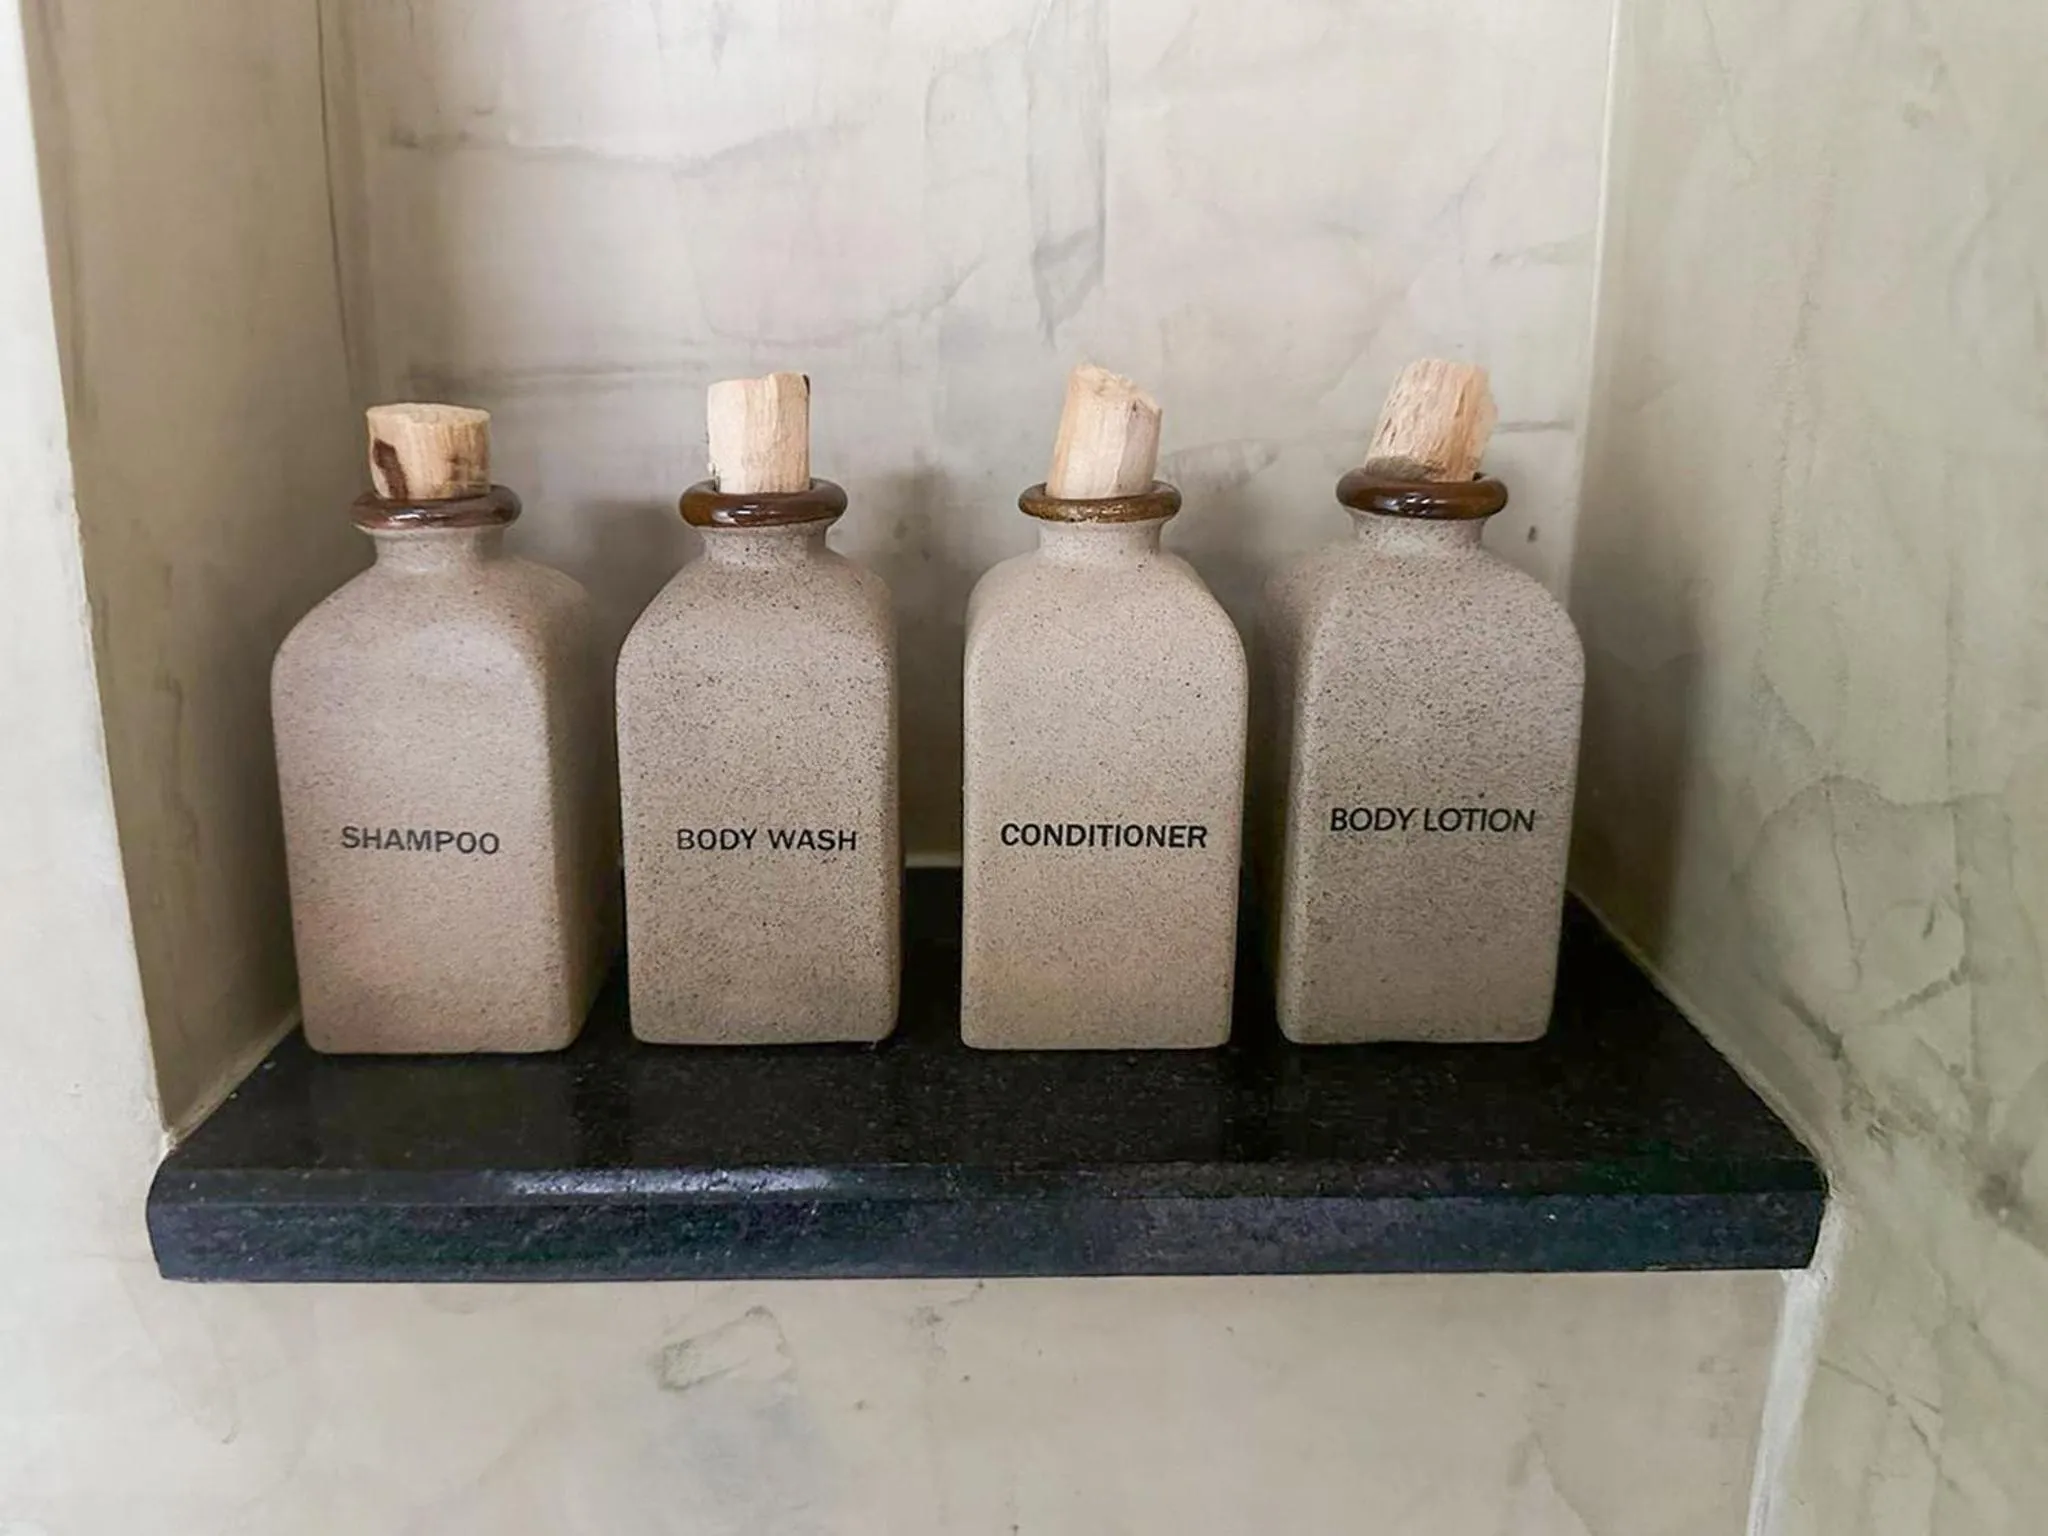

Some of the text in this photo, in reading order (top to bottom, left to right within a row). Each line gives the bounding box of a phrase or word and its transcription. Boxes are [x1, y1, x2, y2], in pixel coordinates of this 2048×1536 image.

[1330, 807, 1536, 834] BODY LOTION
[341, 826, 499, 855] SHAMPOO
[677, 828, 857, 852] BODY WASH
[1000, 823, 1208, 849] CONDITIONER
